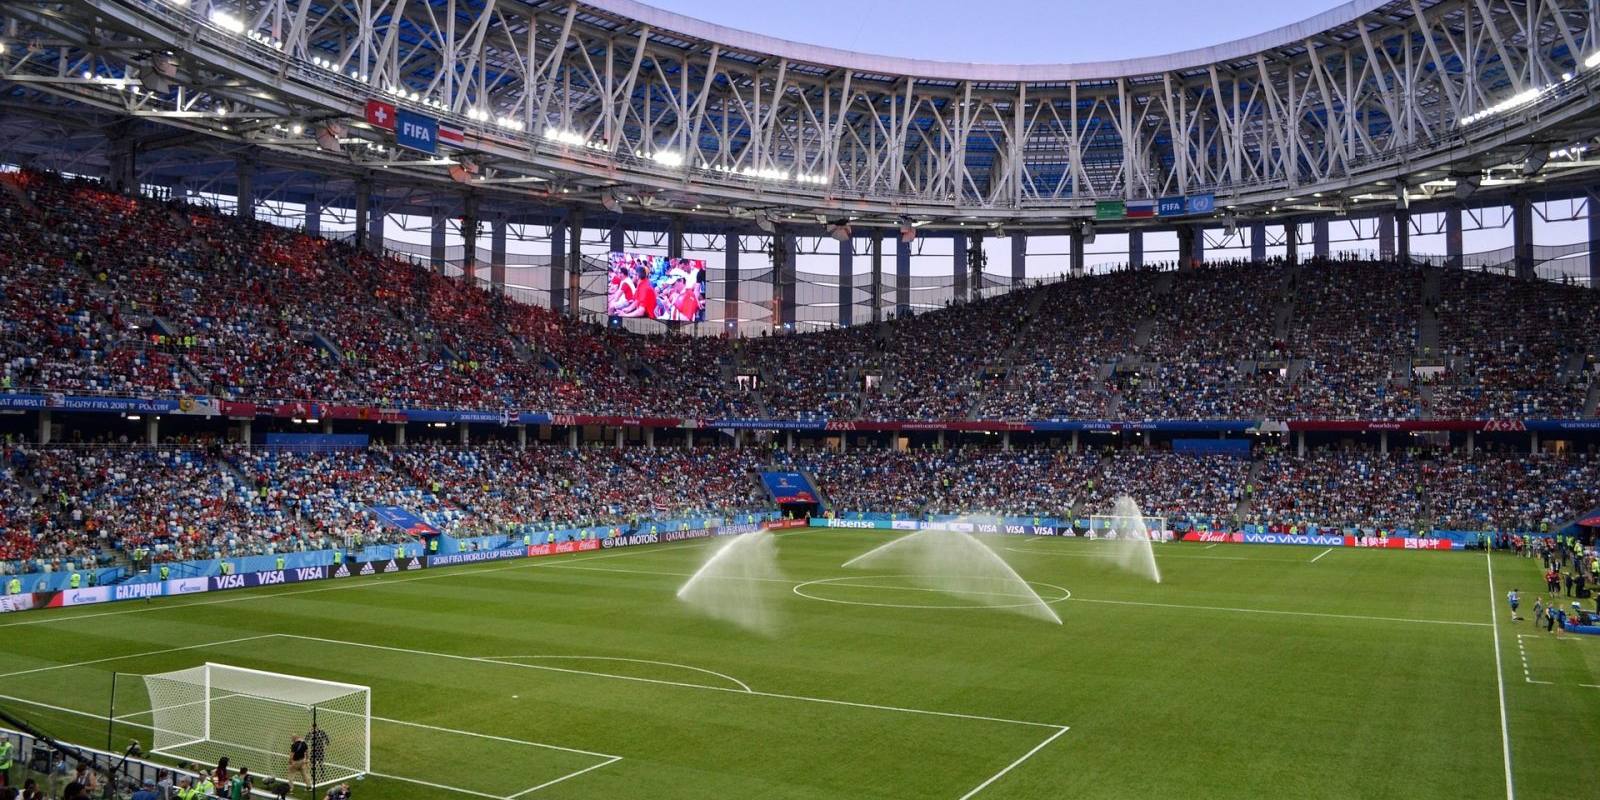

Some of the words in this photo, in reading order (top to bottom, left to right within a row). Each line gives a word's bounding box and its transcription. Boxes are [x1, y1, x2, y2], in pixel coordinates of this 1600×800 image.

[403, 121, 430, 142] FIFA
[1161, 203, 1180, 211] FIFA
[828, 519, 875, 529] Hisense
[978, 524, 997, 533] VISA
[1006, 525, 1025, 534] VISA
[1032, 526, 1054, 535] VISA
[615, 537, 628, 547] KIA
[629, 534, 658, 545] MOTORS
[666, 532, 684, 541] QATAR
[1198, 531, 1225, 542] Bud
[1246, 534, 1276, 543] vivo
[1278, 535, 1309, 544] vivo
[1311, 535, 1342, 545] vivo
[433, 556, 449, 565] 2018
[449, 555, 463, 563] FIFA
[464, 552, 486, 561] WORLD
[486, 550, 499, 559] CUP
[214, 574, 245, 589] VISA
[256, 570, 285, 585] VISA
[296, 567, 322, 581] VISA
[116, 582, 162, 599] GAZPROM
